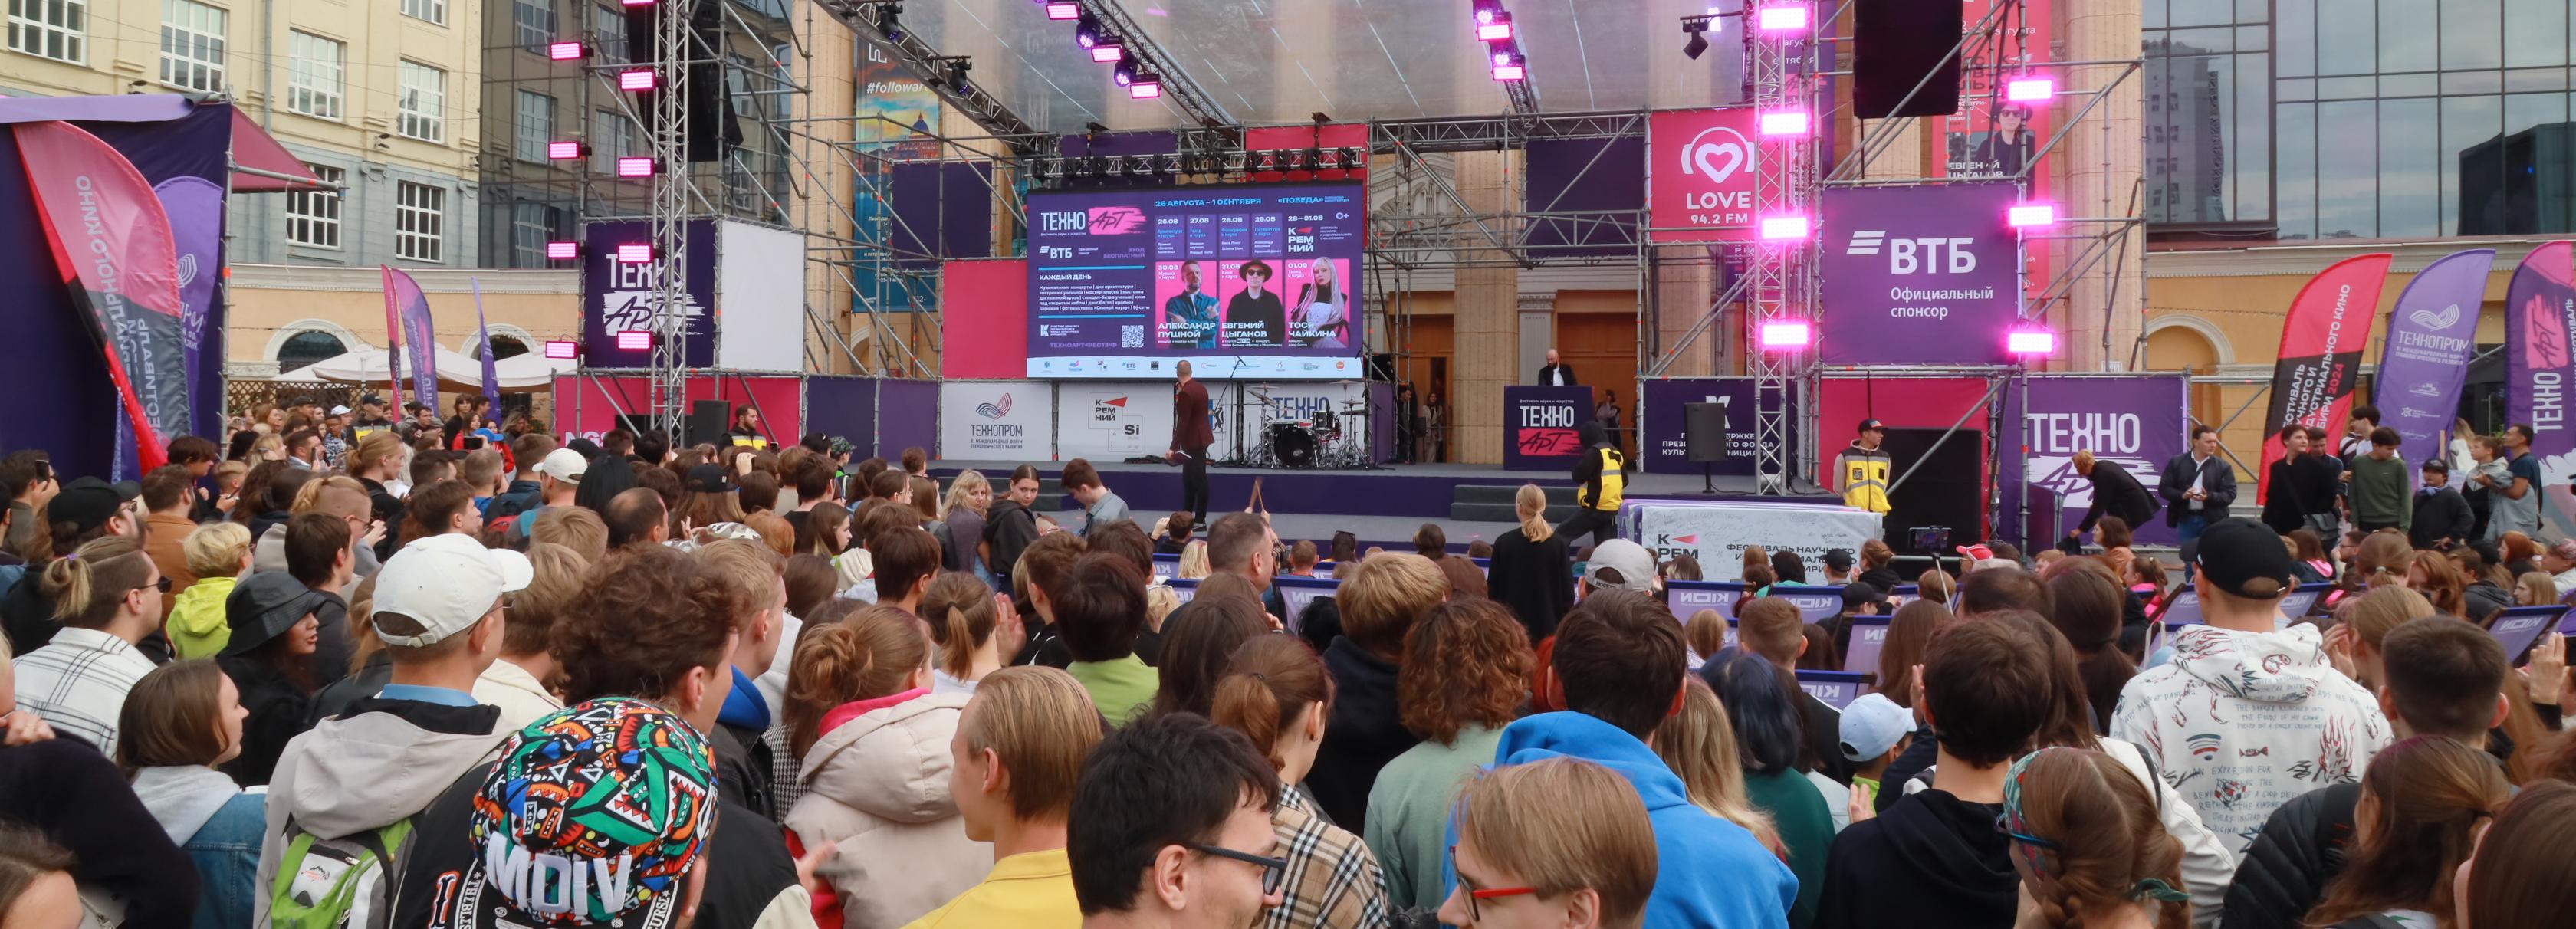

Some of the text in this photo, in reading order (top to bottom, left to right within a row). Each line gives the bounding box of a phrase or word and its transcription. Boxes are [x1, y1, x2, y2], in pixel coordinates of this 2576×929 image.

[1687, 191, 1752, 210] LOVE
[1040, 212, 1086, 231] ТЕХНО
[1089, 211, 1135, 230] АРТ
[1336, 212, 1349, 220] 0+
[1691, 212, 1748, 224] 94.2 FM
[1288, 227, 1296, 235] К
[1050, 248, 1072, 259] ВТБ
[1288, 243, 1314, 253] НИЙ
[1891, 237, 1976, 274] ВТБ
[1891, 286, 1993, 303] Официальный
[2334, 284, 2351, 320] КИНО
[1891, 307, 1948, 320] спонсор
[1222, 321, 1264, 329] ЕВГЕНИЙ
[1158, 330, 1201, 338] ПУШНОЙ
[1288, 329, 1336, 338] ЧАЙКИНА
[2399, 330, 2470, 352] ТЕХНОПРОМ
[2317, 363, 2345, 429] БИРИ 2024
[1273, 396, 1329, 419] ТЕХНО
[2533, 372, 2563, 434] ТЕХНО
[1095, 413, 1116, 421] НИЙ
[1519, 405, 1575, 427] ТЕХНО
[971, 424, 1023, 437] ТЕХНОПРОМ
[1124, 424, 1140, 435] Si
[2027, 412, 2141, 453] ТЕХНО
[1519, 431, 1573, 453] АРТ
[1658, 534, 1670, 545] К
[1658, 548, 1699, 559] РЕМ
